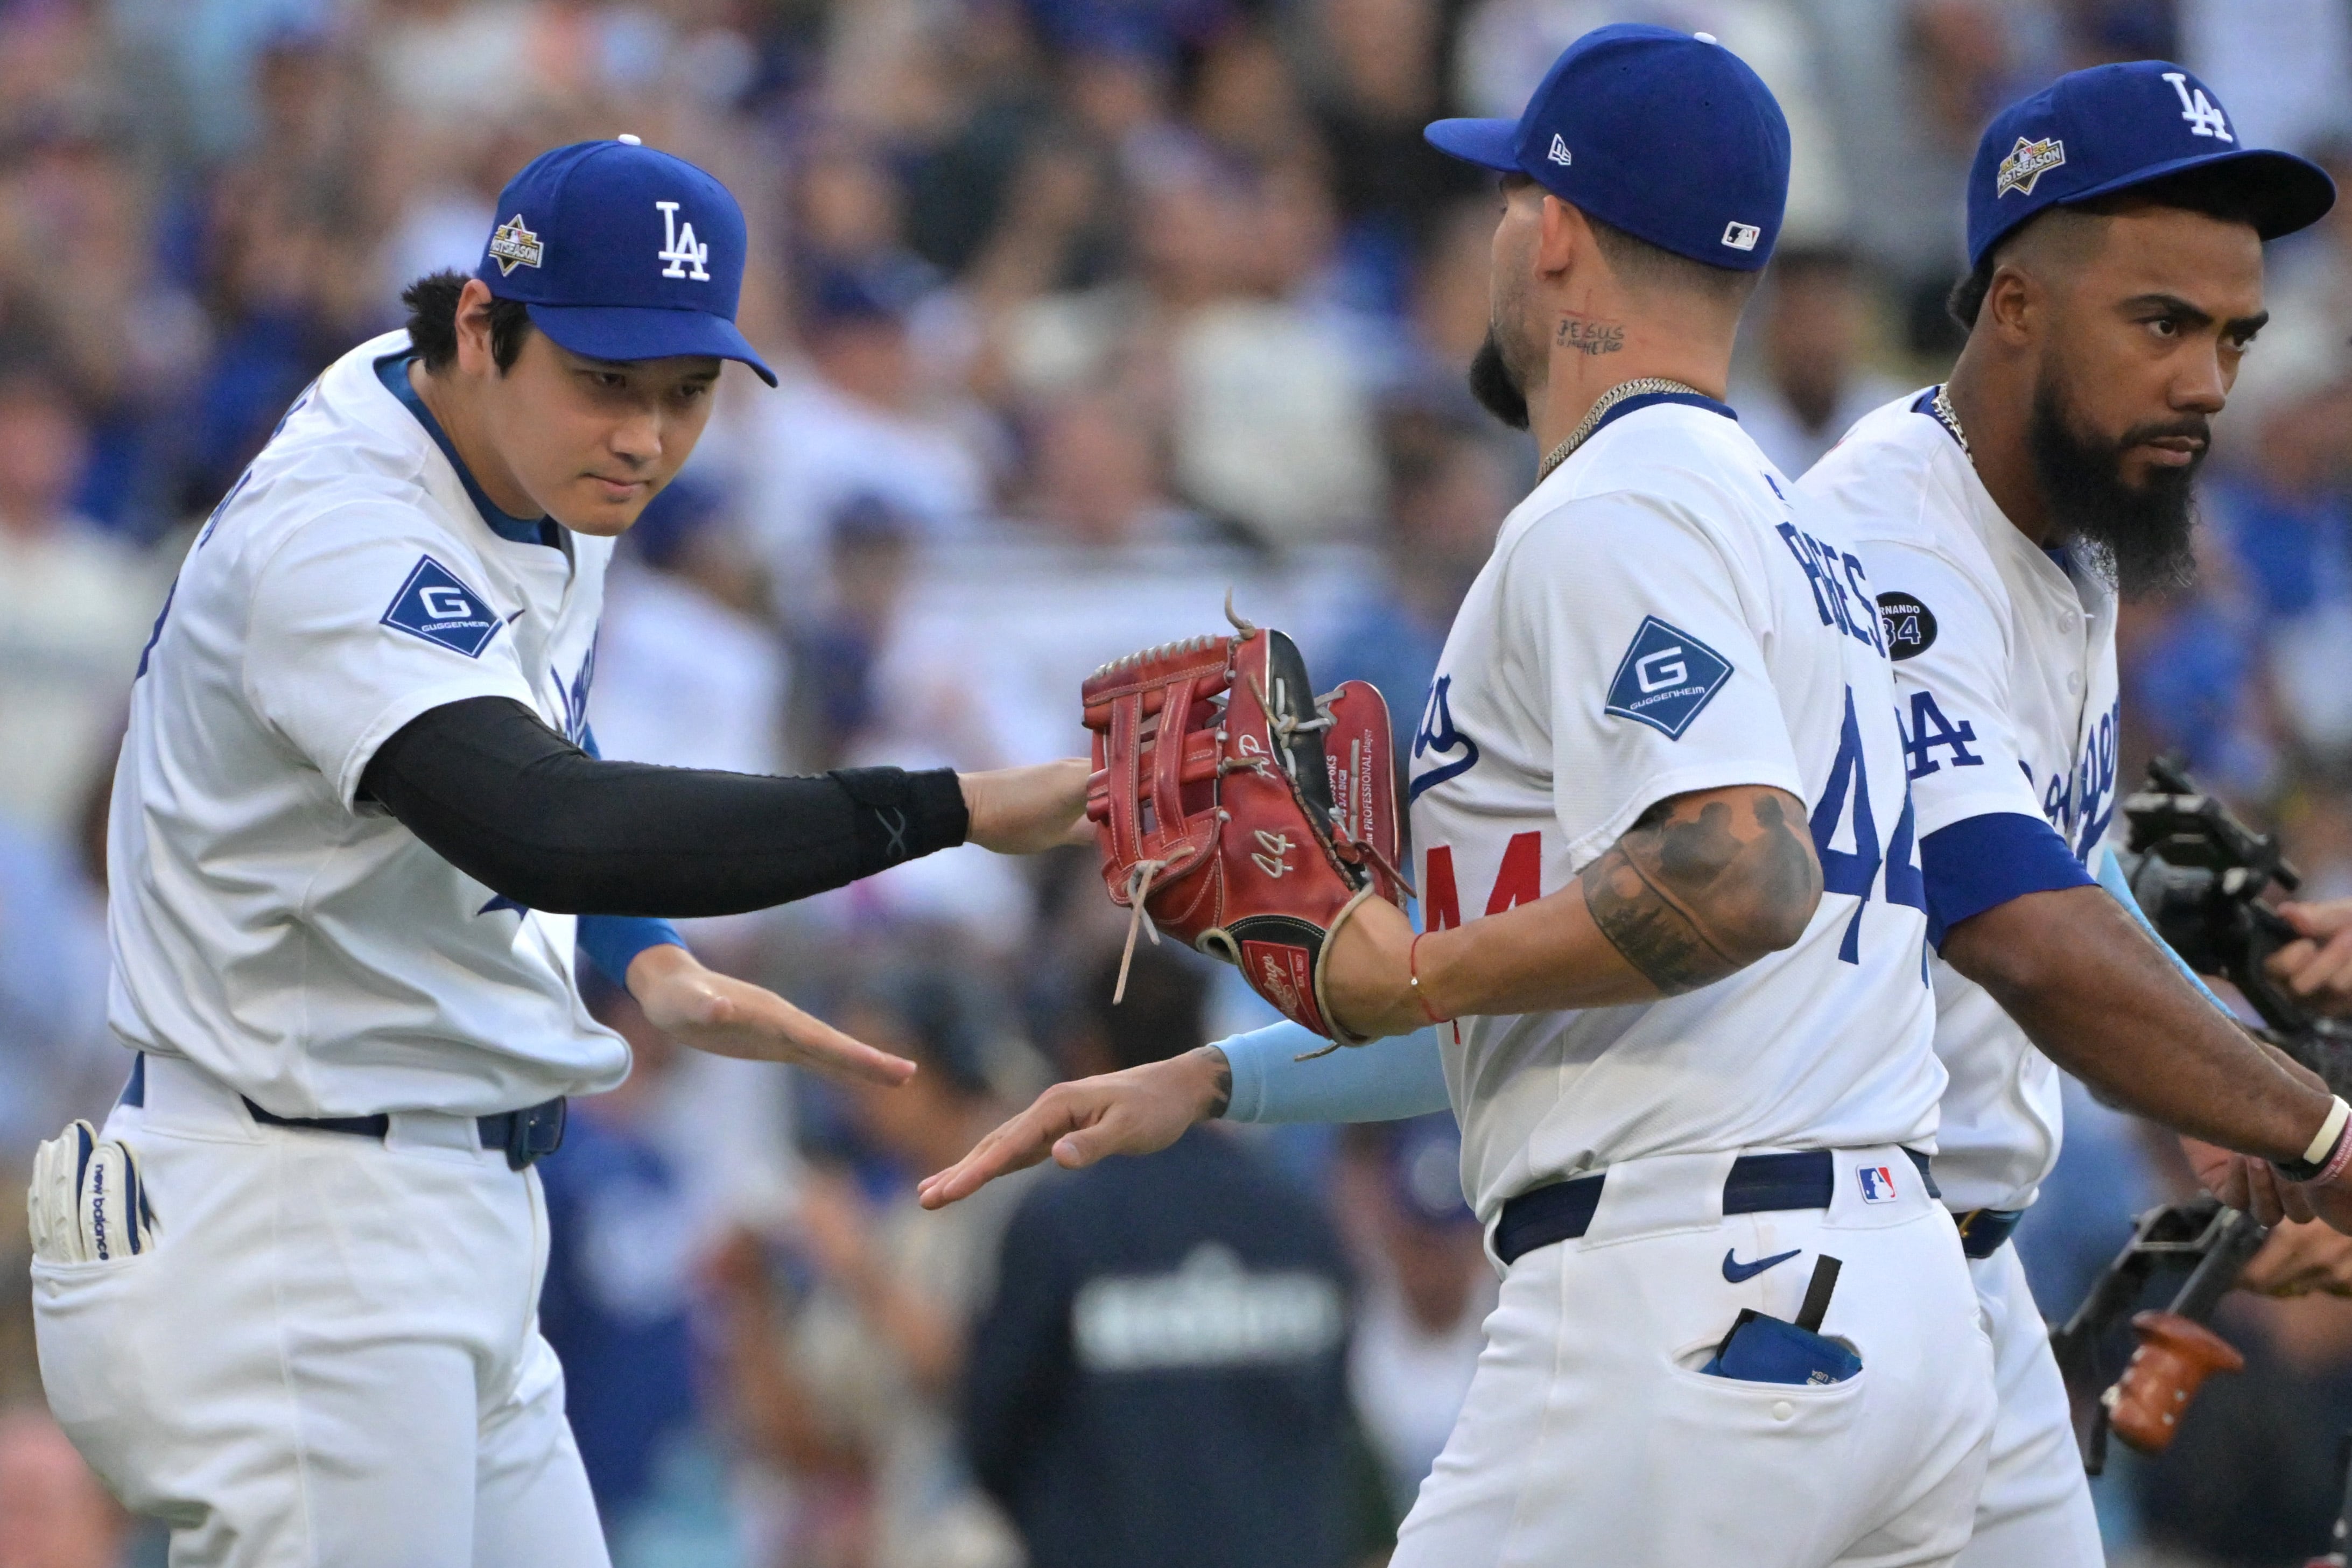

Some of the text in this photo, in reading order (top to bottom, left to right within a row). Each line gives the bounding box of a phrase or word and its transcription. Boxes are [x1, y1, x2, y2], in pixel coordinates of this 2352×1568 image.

[2161, 73, 2233, 143] LA
[656, 201, 710, 282] LA
[1557, 320, 1625, 340] JESUS
[419, 587, 472, 618] G
[1879, 604, 1921, 615] RNANDO
[422, 621, 490, 632] GUGGENHEIM
[1635, 646, 1688, 693] G
[1630, 686, 1705, 710] GUGGENHEIM
[1362, 755, 1374, 831] PROFESSIONAL
[1251, 830, 1296, 878] 44
[93, 1164, 109, 1261] new balance
[1812, 1369, 1829, 1382] USA
